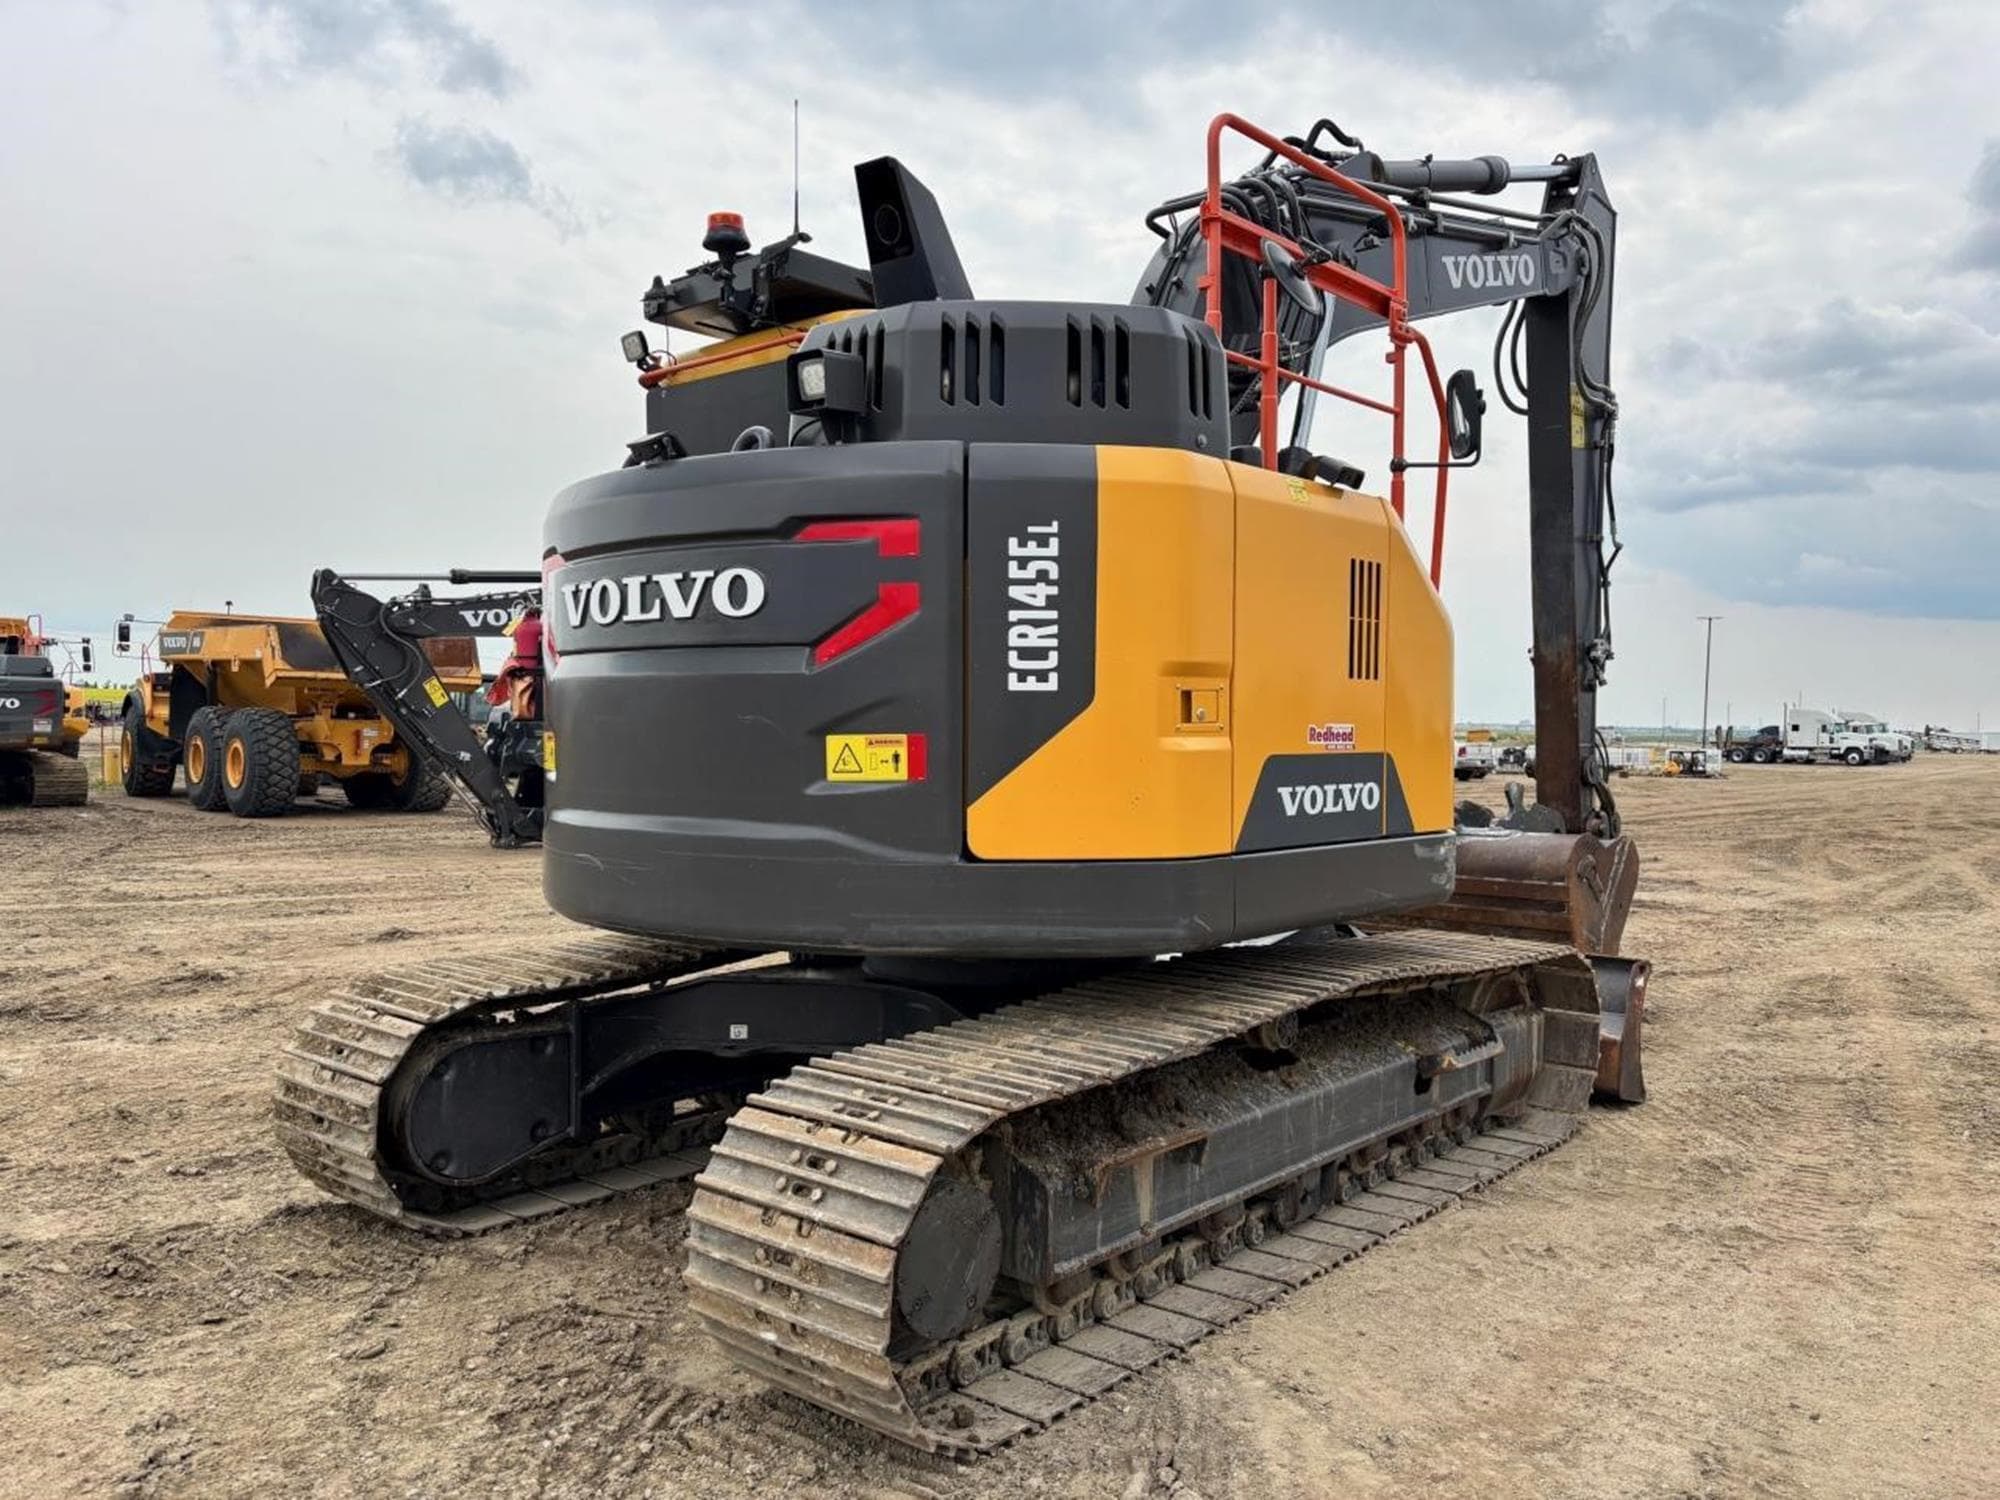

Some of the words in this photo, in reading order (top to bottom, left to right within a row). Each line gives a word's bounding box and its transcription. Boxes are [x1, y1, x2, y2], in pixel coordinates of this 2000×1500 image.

[1441, 253, 1535, 289] VOLVO
[561, 567, 765, 627] VOLVO
[1008, 520, 1059, 691] ECR145EL
[1309, 726, 1354, 742] Redhead
[1277, 782, 1380, 816] VOLVO
